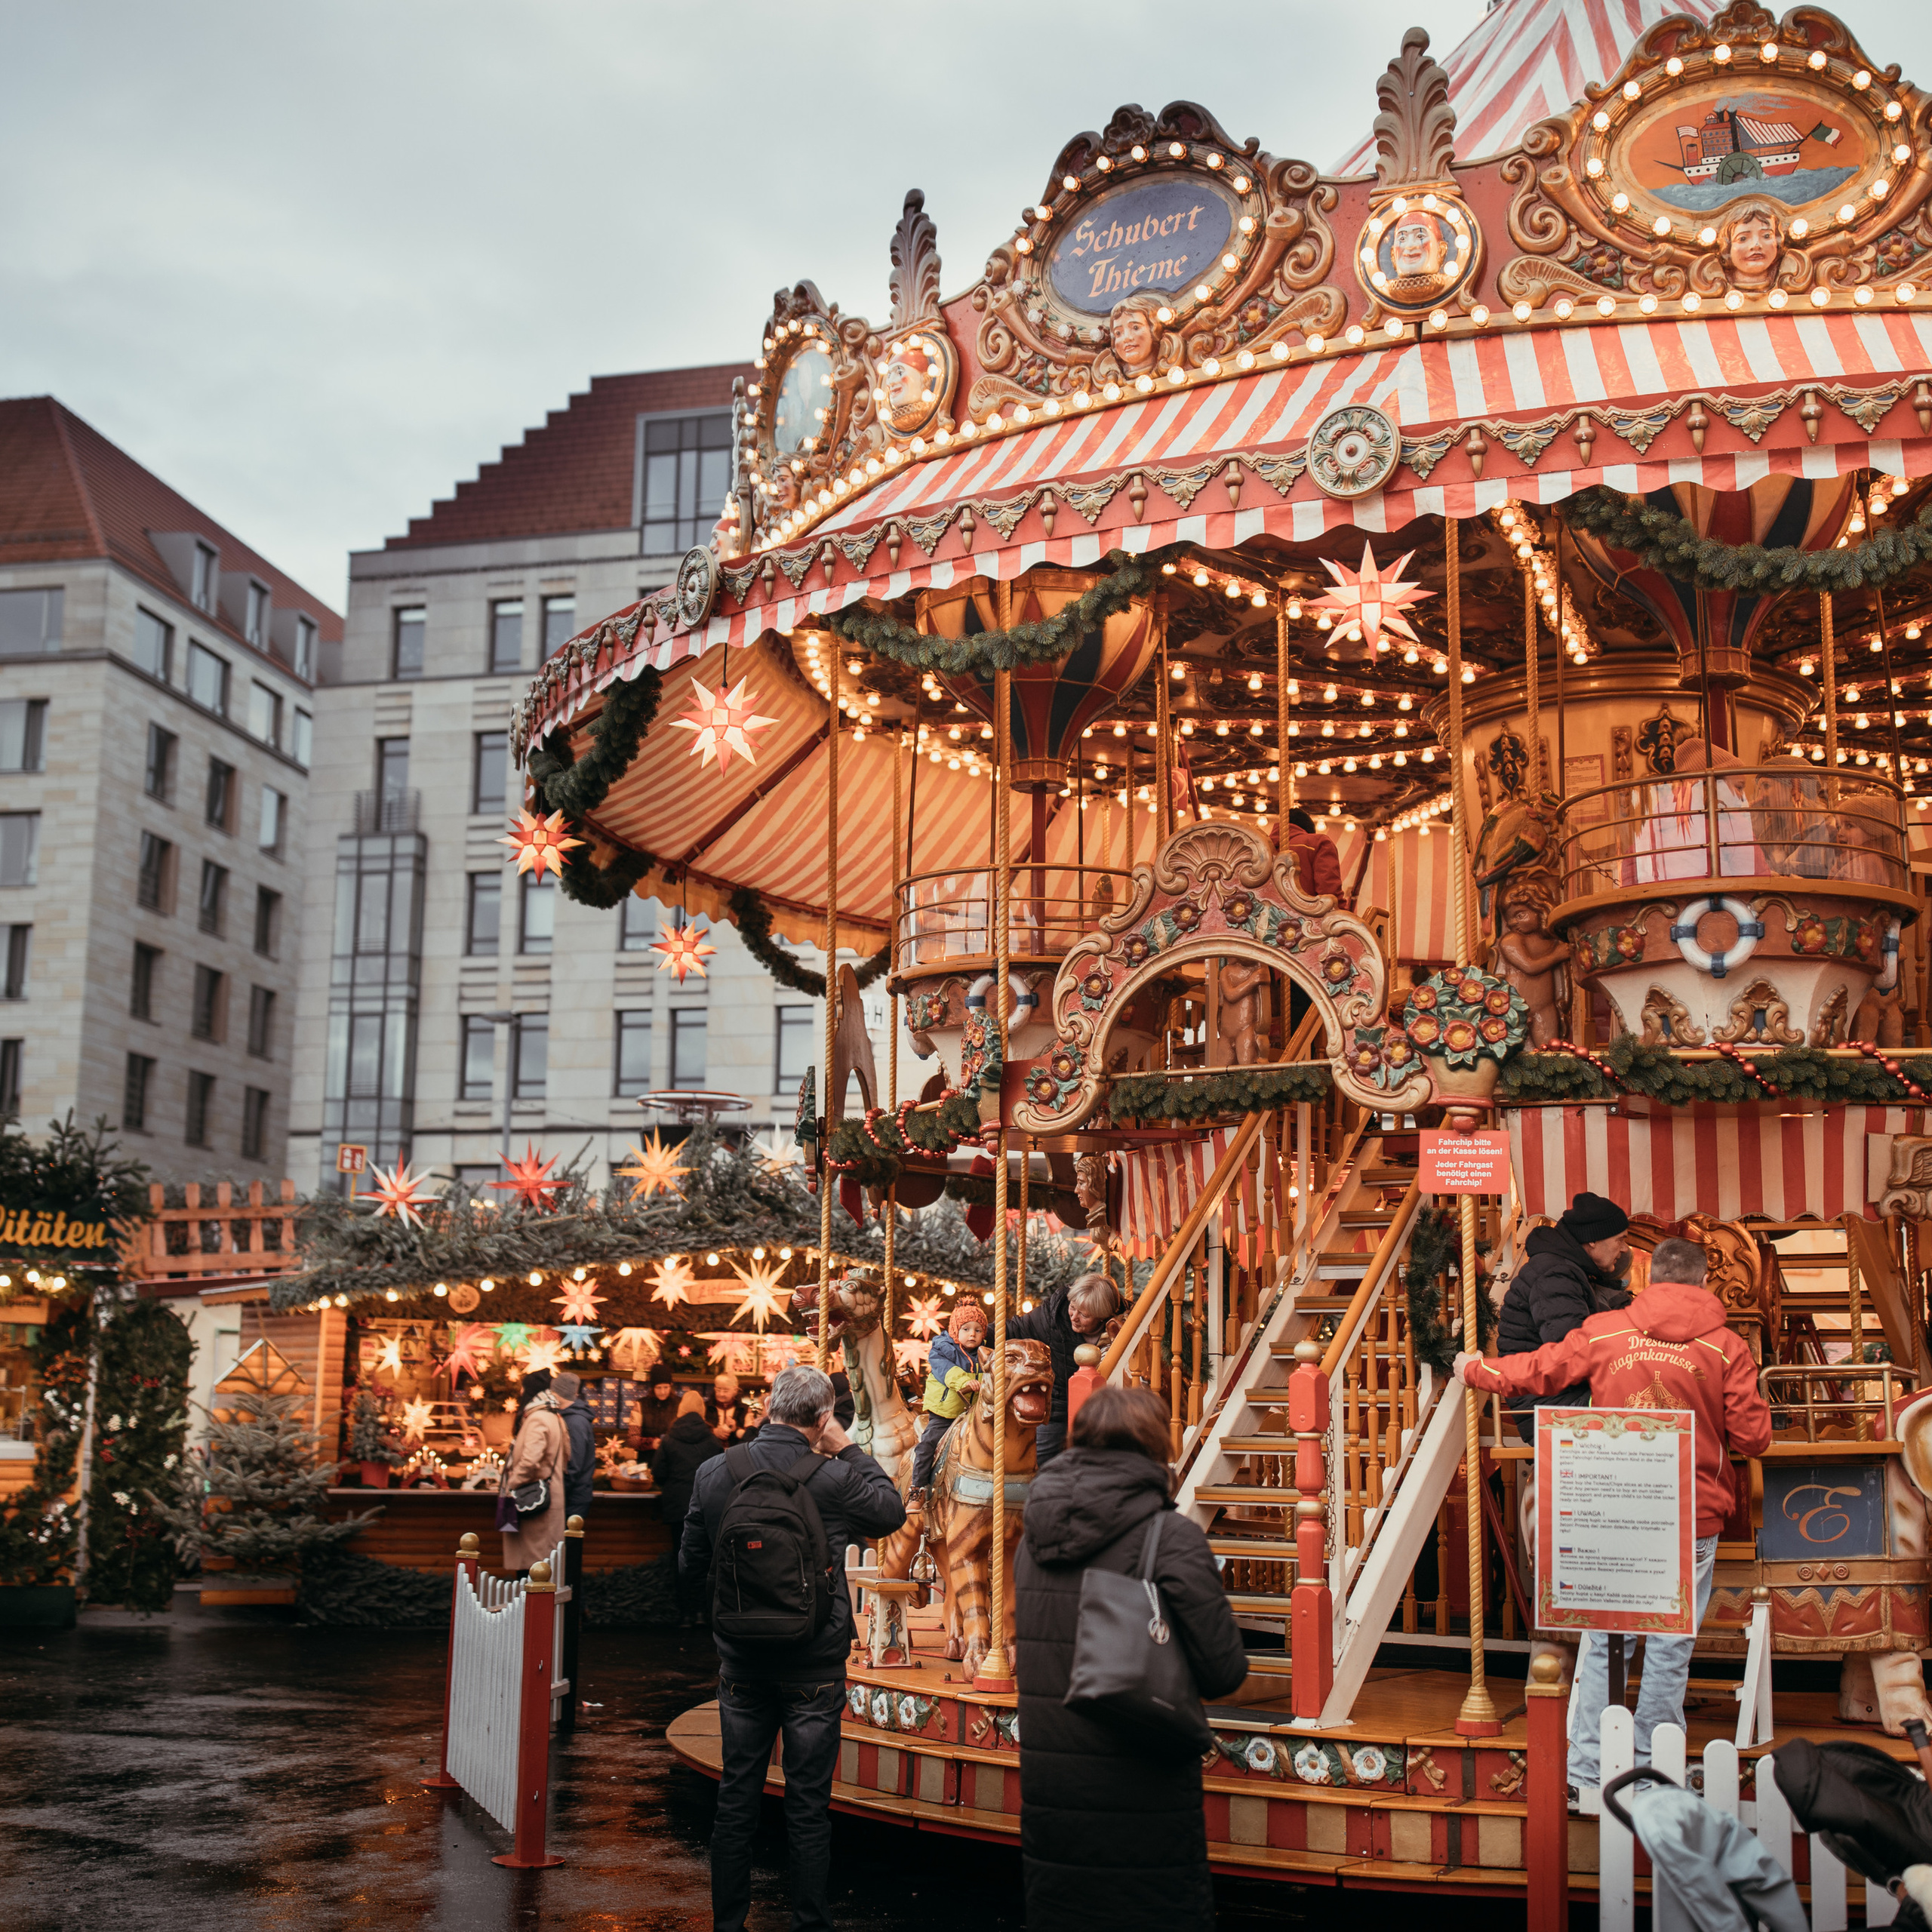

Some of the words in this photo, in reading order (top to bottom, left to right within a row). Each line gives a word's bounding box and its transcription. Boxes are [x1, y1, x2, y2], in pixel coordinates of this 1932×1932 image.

[1069, 205, 1205, 257] Schubert
[1088, 254, 1189, 298] Thieme
[1438, 1138, 1472, 1146] Fahrchip
[1459, 1161, 1493, 1170] Fahrgast
[1437, 1170, 1469, 1178] benötigt
[1445, 1179, 1482, 1187] Fahrchip!
